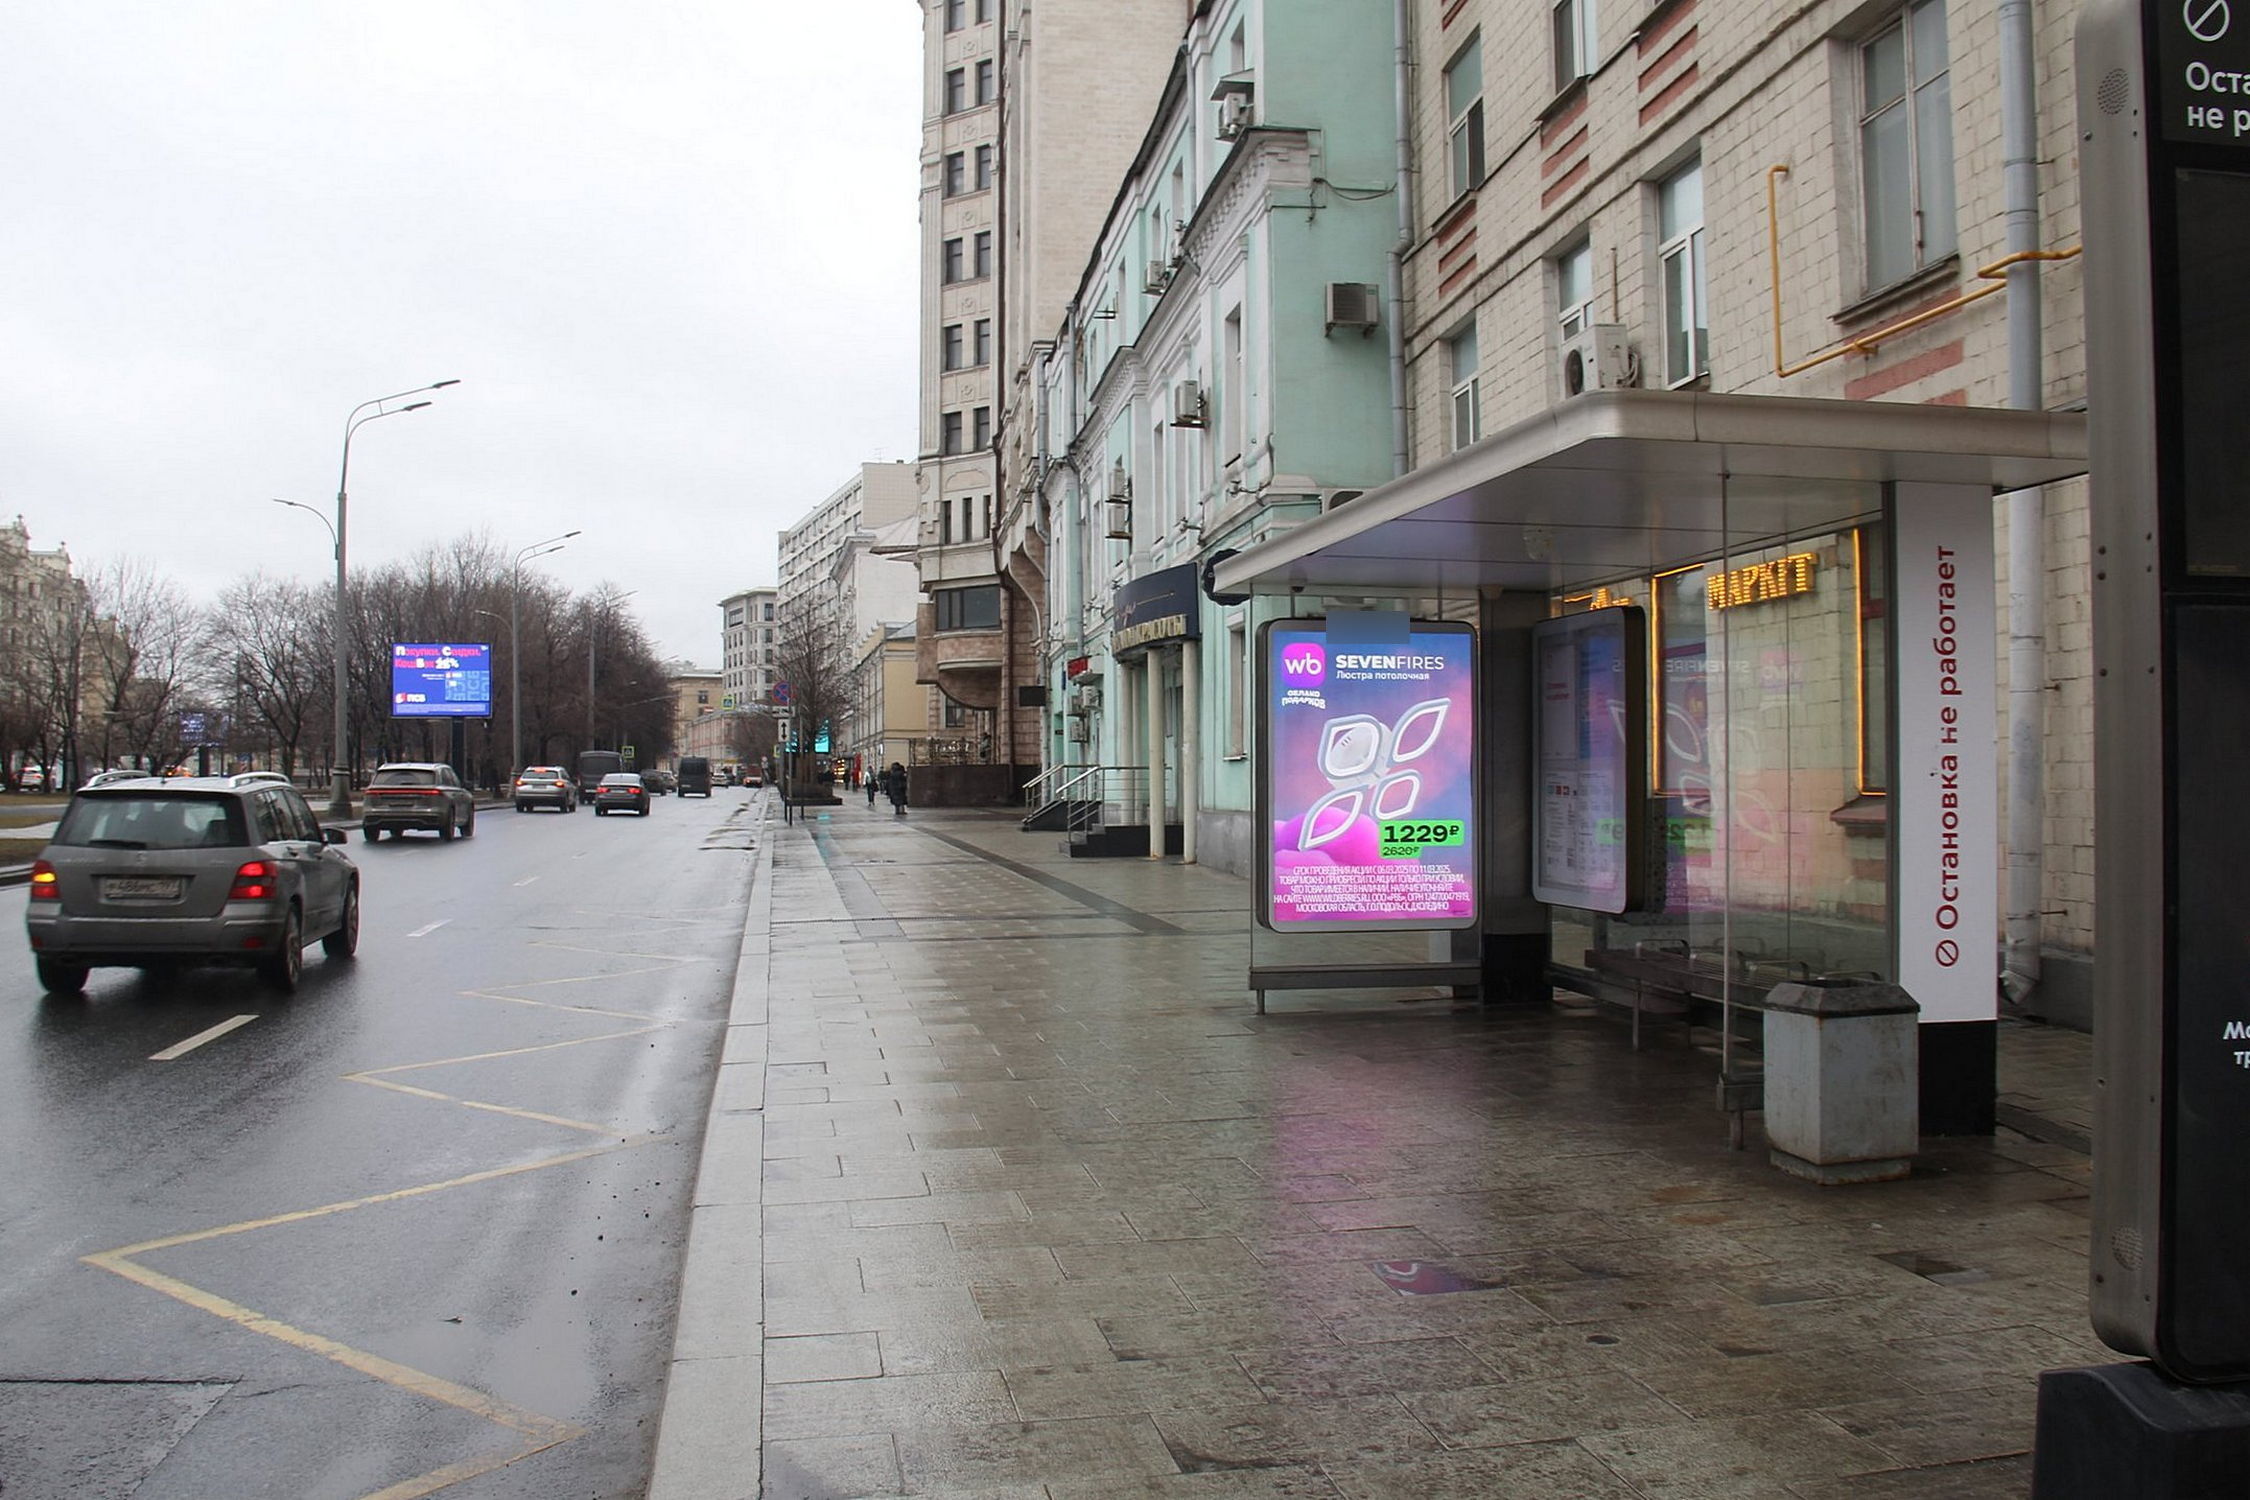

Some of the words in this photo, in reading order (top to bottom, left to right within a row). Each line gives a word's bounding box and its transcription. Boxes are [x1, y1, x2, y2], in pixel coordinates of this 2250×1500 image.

[2187, 106, 2224, 129] не
[1933, 546, 1963, 696] работает
[1284, 652, 1322, 675] wb
[1335, 654, 1445, 670] SEVENFIRES
[1336, 670, 1373, 681] Люстра
[1375, 672, 1430, 681] потолочная
[1941, 706, 1958, 744] не
[1936, 755, 1959, 930] Остановка
